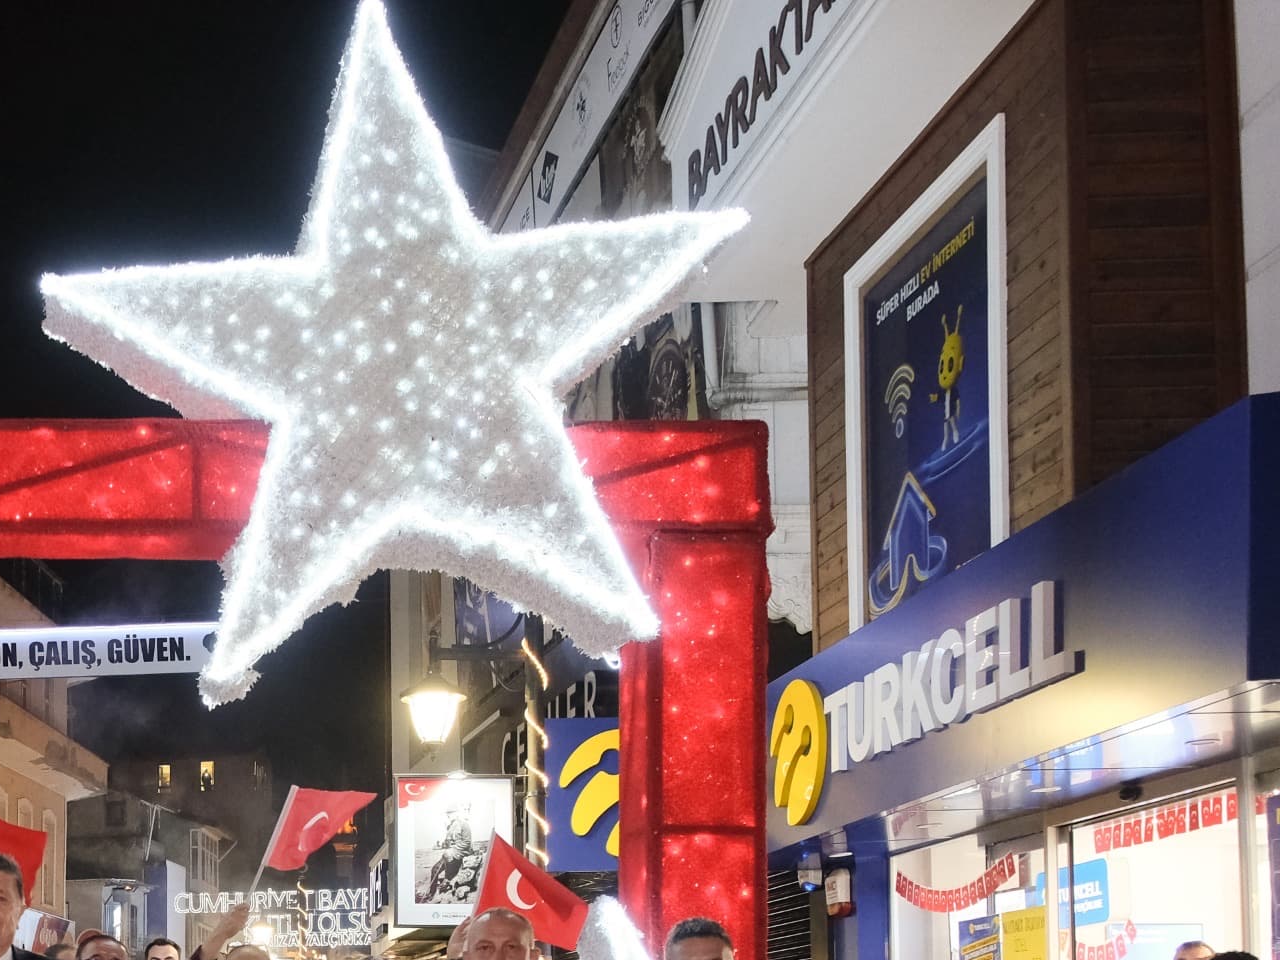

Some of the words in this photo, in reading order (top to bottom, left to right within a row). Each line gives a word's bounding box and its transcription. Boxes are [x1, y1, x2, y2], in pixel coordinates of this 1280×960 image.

[688, 0, 837, 211] BAYRAKTA
[876, 293, 899, 326] SÜPER
[920, 261, 931, 284] EV
[932, 216, 974, 273] İNTERNETİ
[906, 280, 940, 322] BURADA
[28, 639, 102, 671] ÇALIŞ,
[107, 634, 191, 664] GÜVEN.
[823, 580, 1075, 774] TURKCELL
